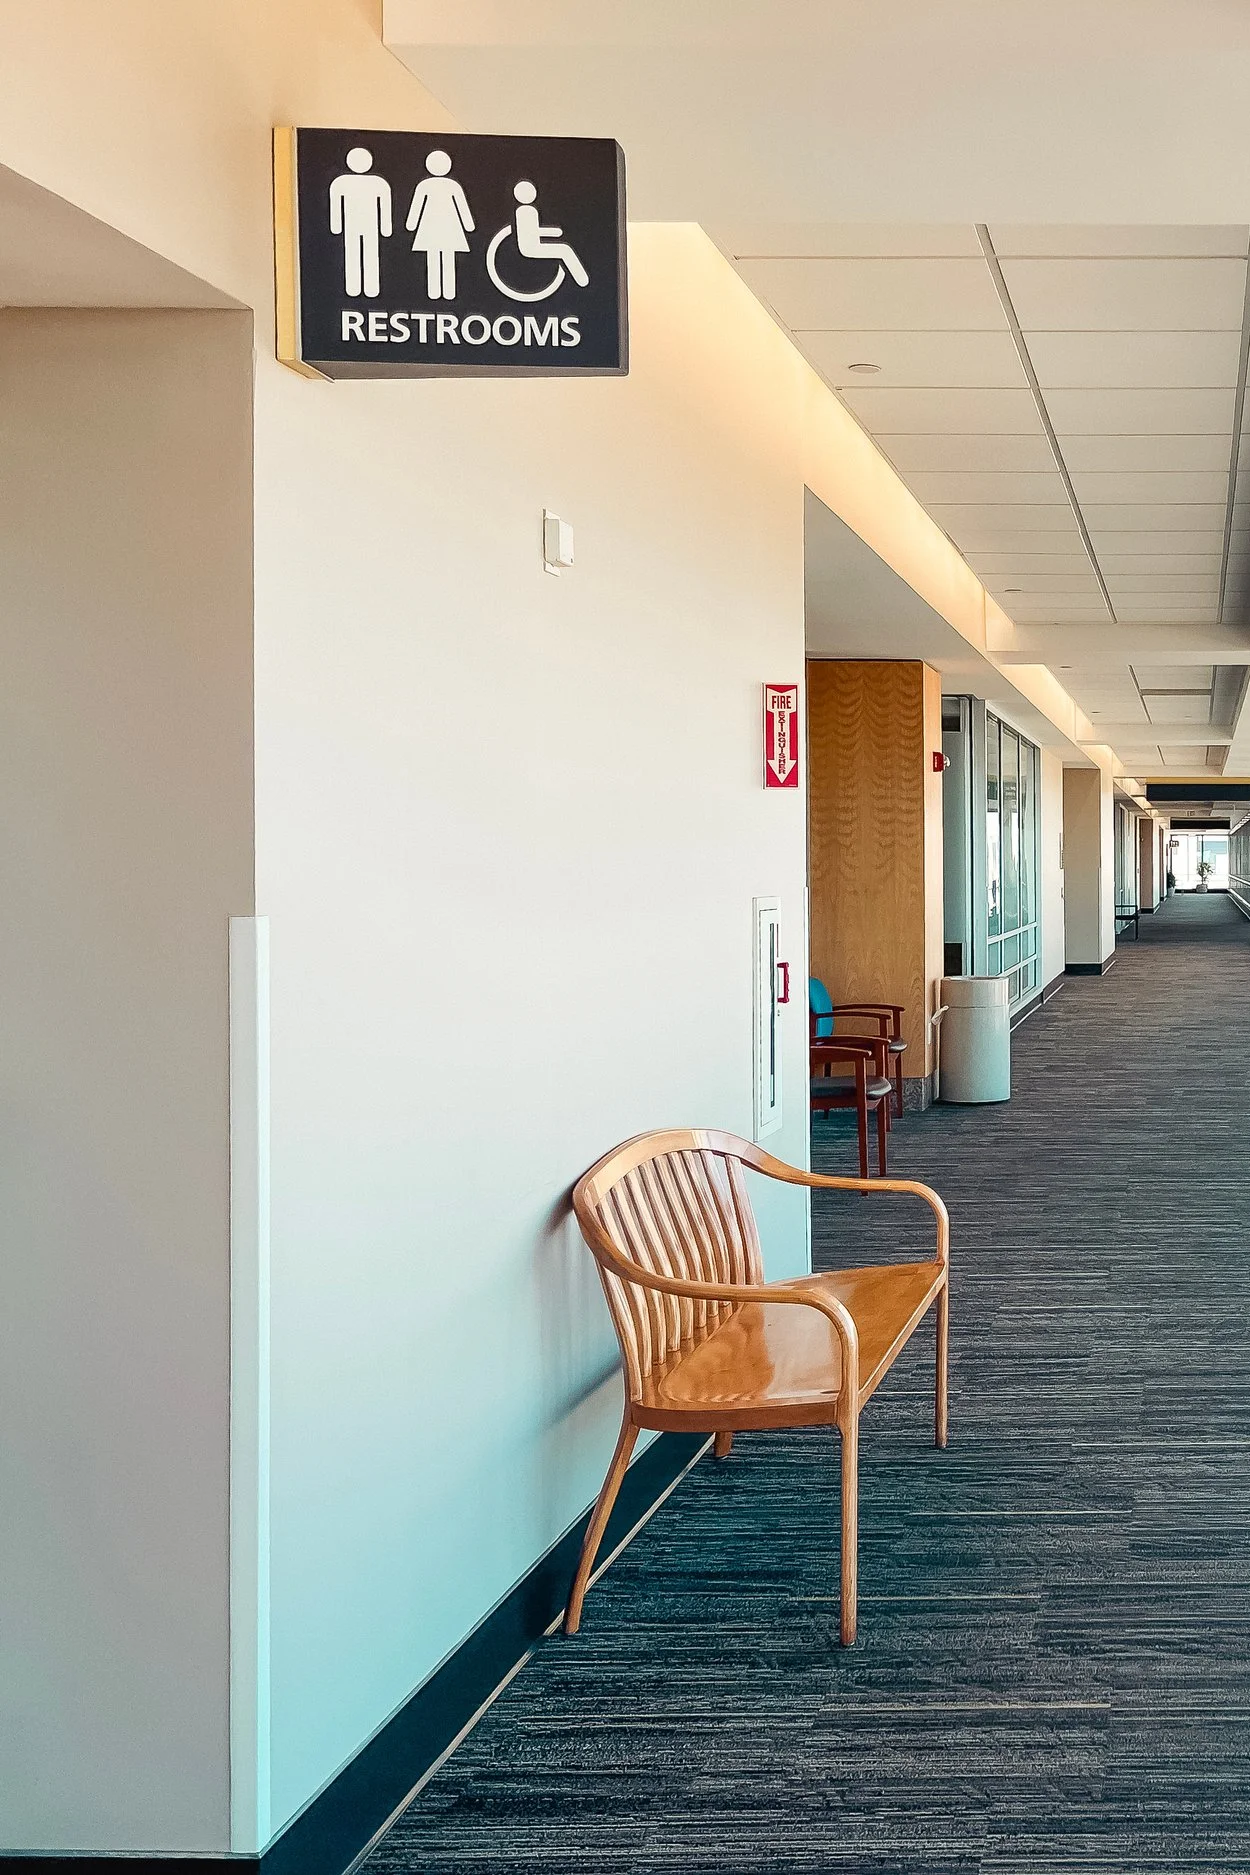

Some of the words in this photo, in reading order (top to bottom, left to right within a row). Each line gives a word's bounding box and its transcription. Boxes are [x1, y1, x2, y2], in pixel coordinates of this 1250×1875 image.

[341, 310, 581, 347] RESTROOMS
[771, 695, 792, 710] FIRE
[778, 711, 786, 774] EXTINGUISHER
